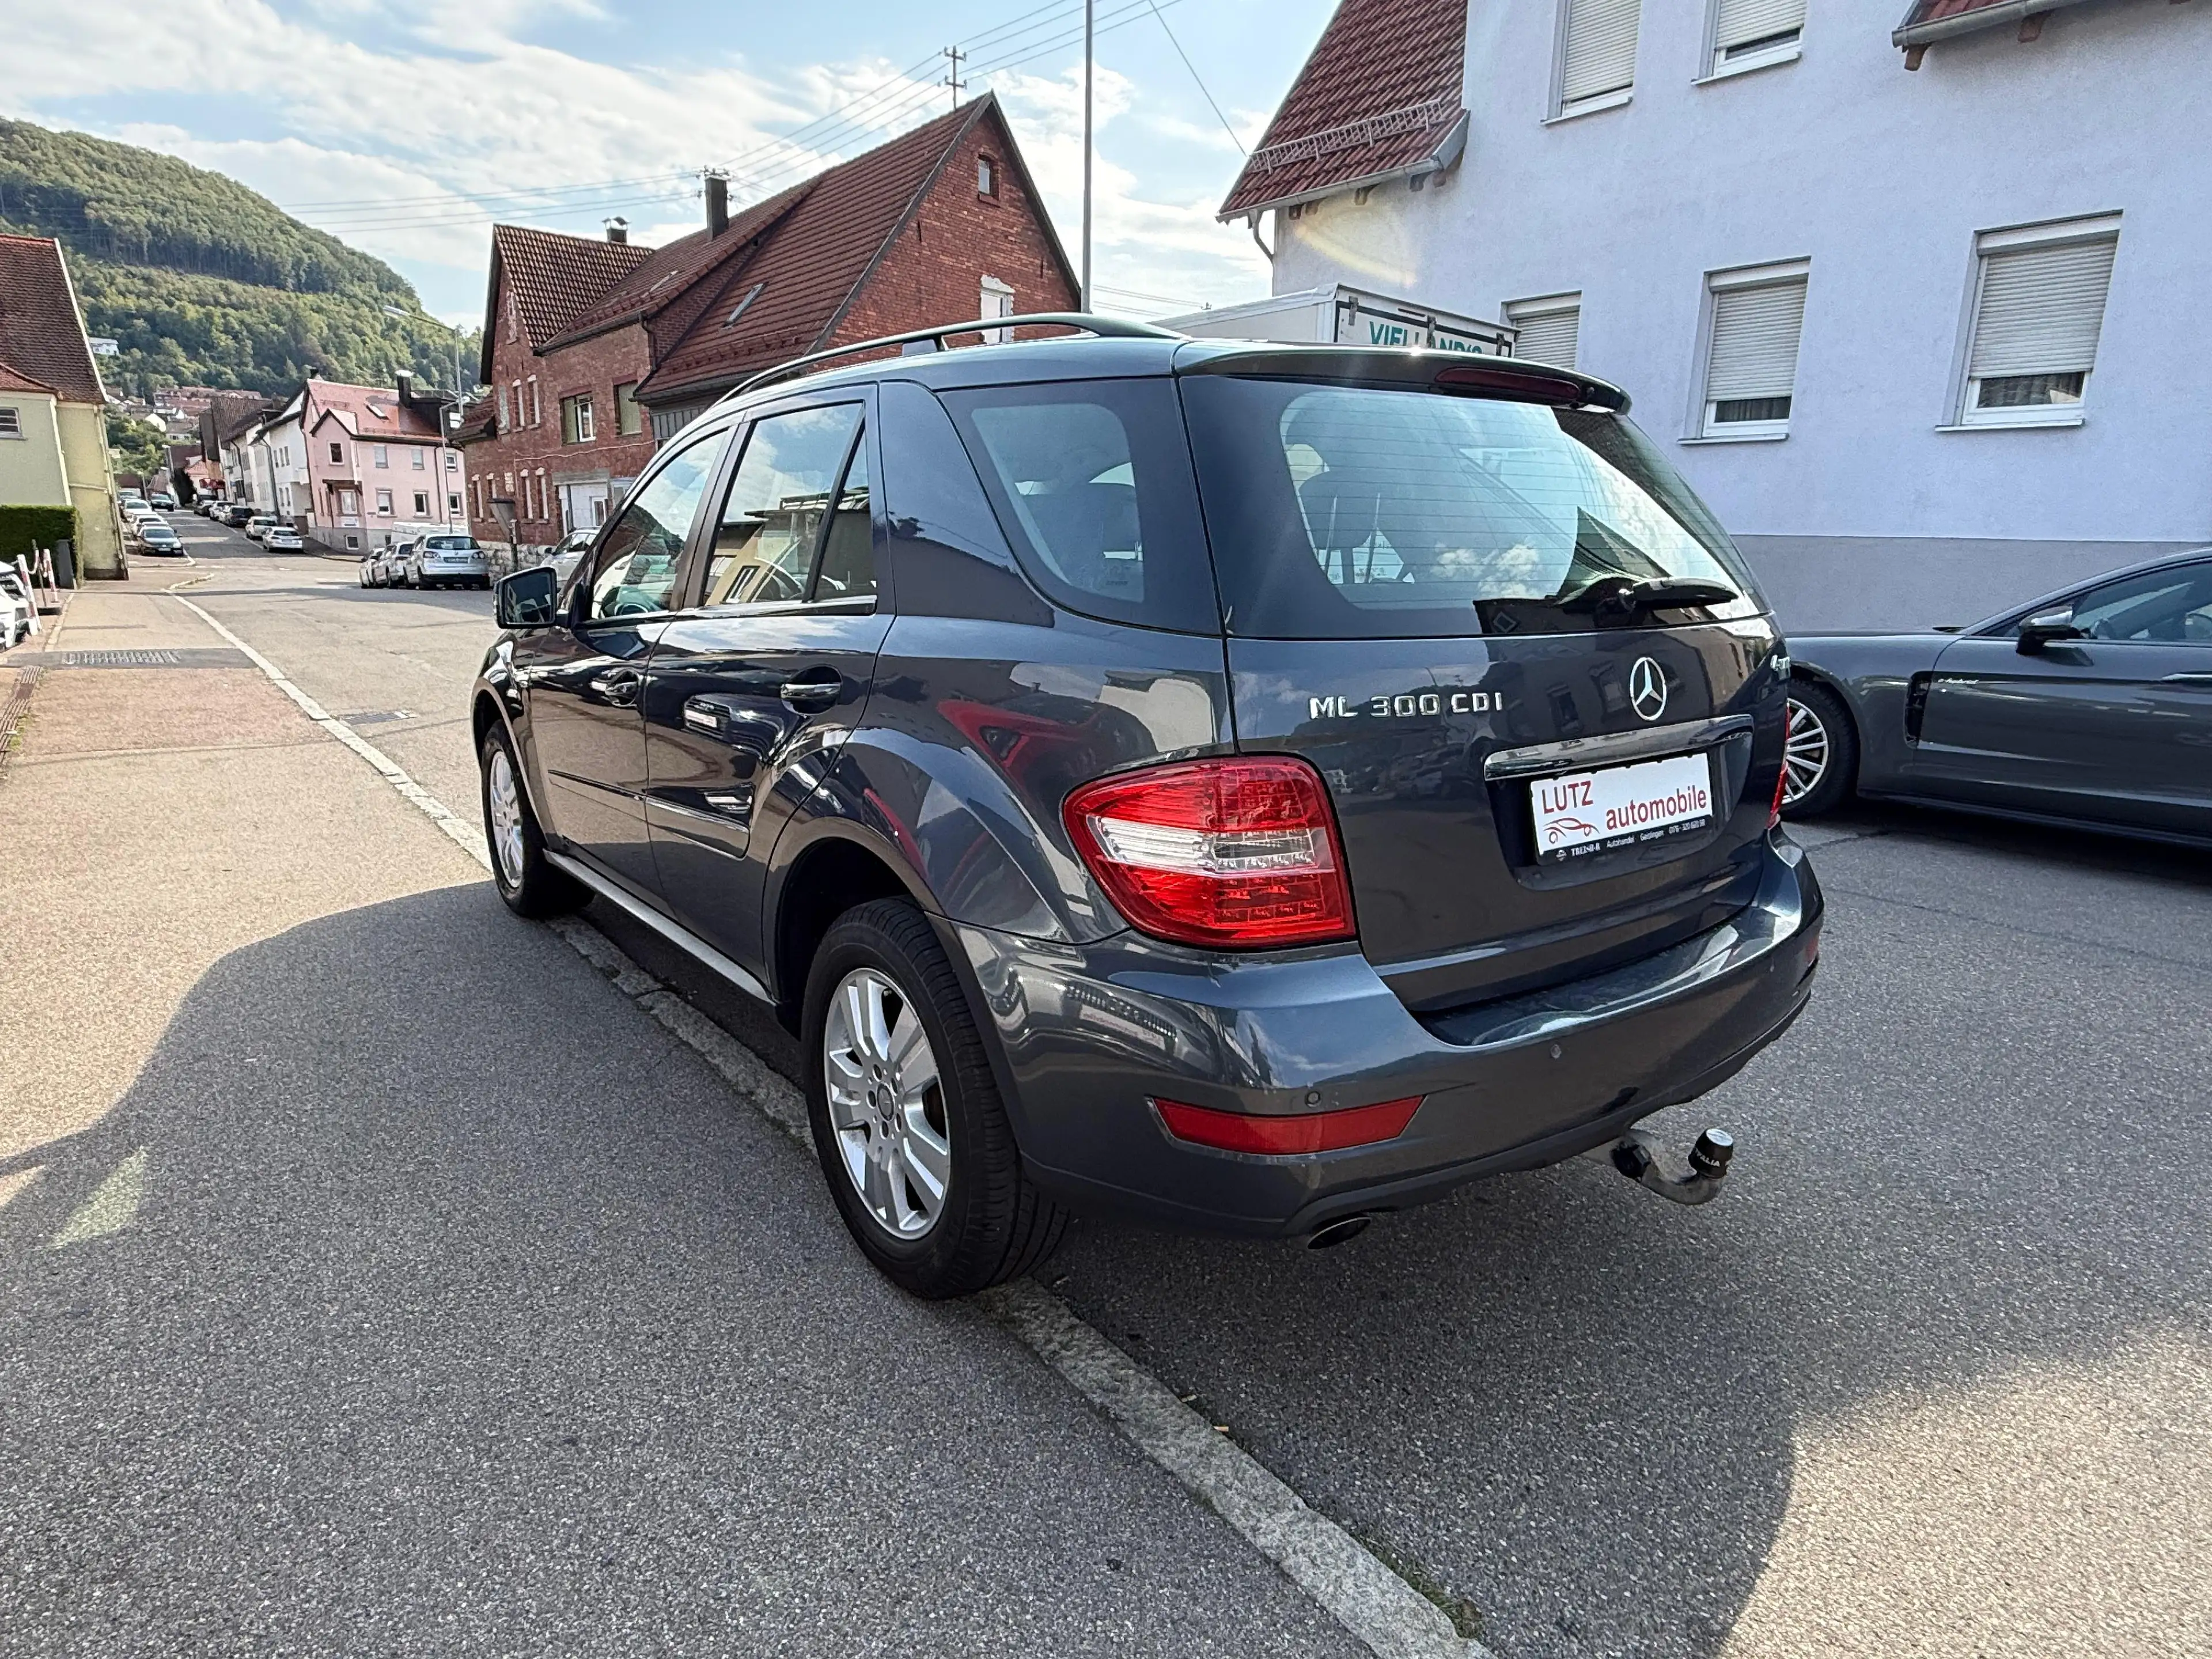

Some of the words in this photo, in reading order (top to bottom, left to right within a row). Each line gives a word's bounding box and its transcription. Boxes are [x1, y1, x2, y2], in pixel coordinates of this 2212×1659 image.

[1309, 696, 1358, 719] ML
[1370, 694, 1440, 717] 300
[1451, 692, 1502, 713] CDI
[1542, 781, 1594, 814] LUTZ
[1606, 785, 1707, 831] automobile
